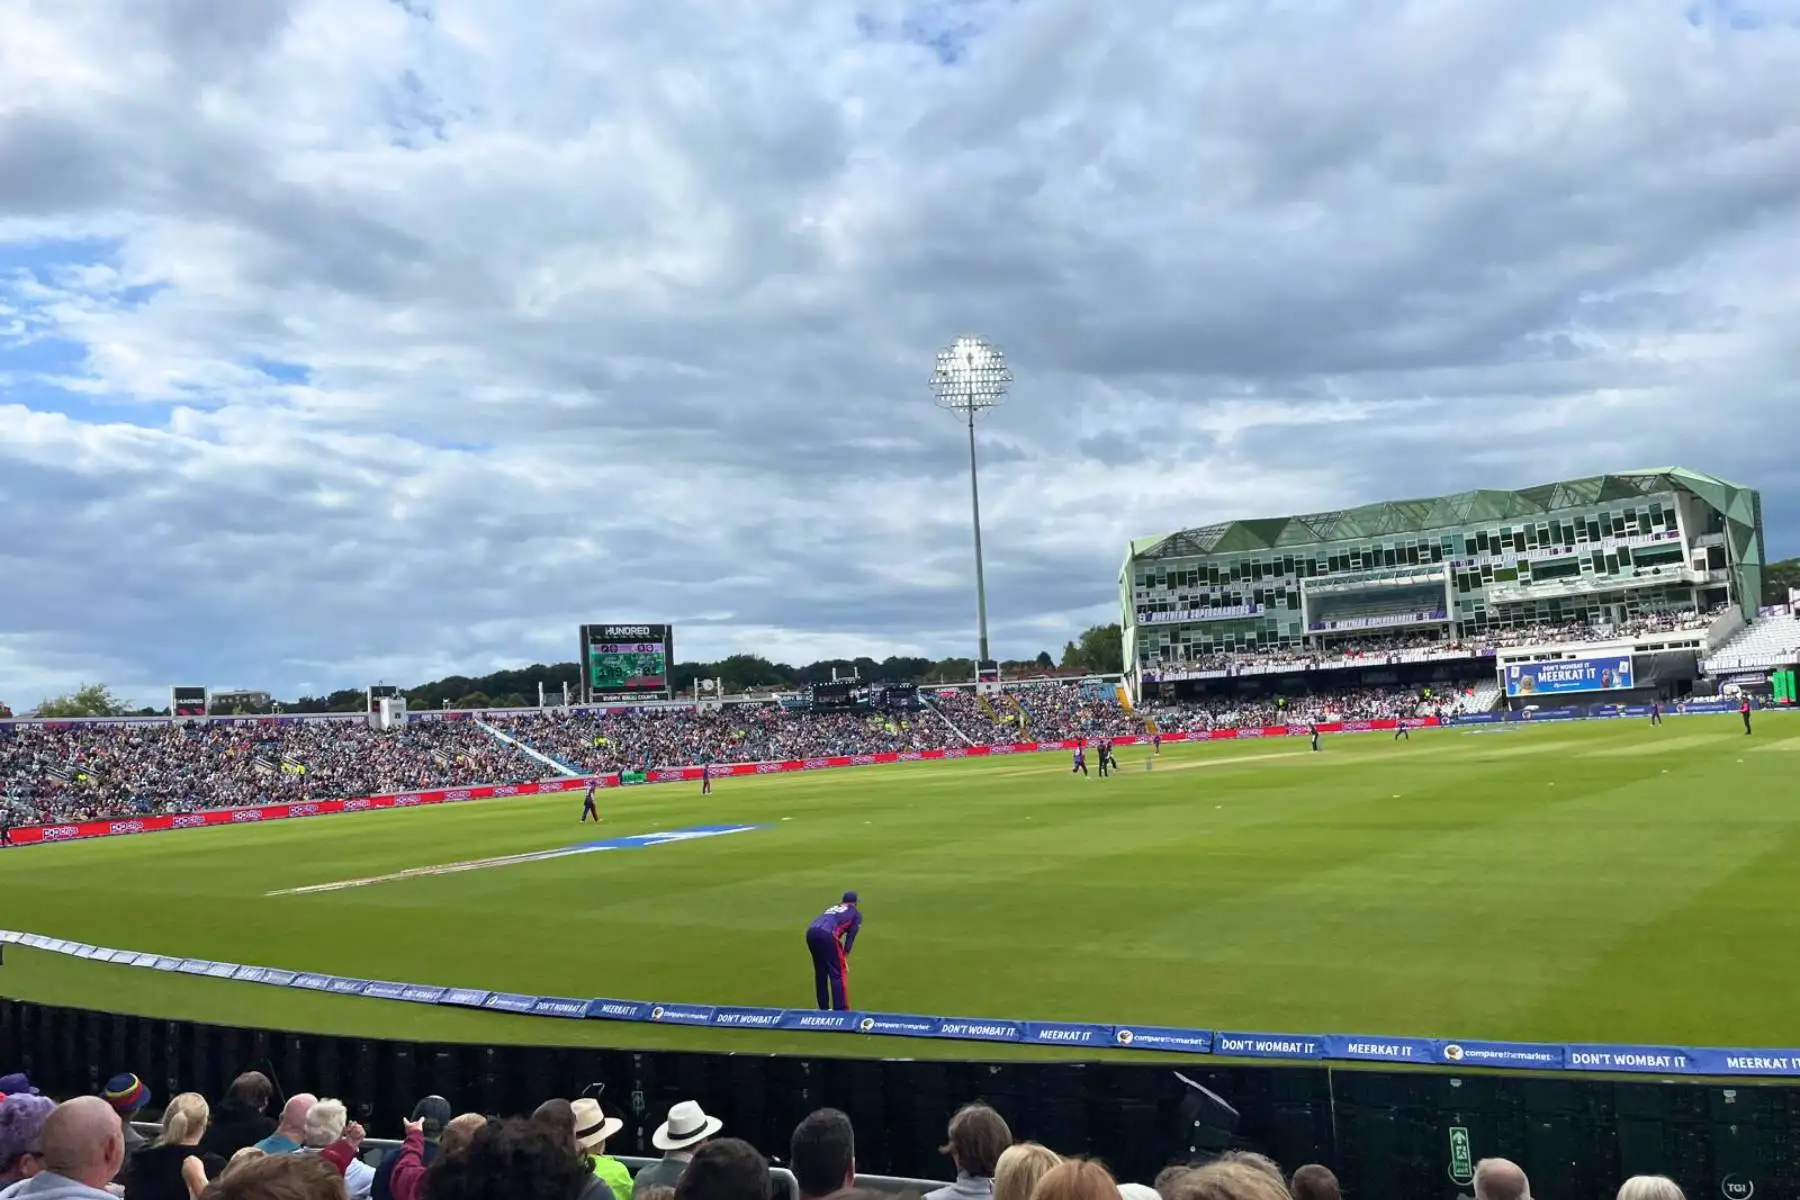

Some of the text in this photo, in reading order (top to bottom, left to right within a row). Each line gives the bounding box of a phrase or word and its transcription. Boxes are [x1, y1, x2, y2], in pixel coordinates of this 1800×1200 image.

[605, 627, 650, 635] HUNDRED
[1538, 668, 1596, 682] MEERKAT IT
[602, 1004, 638, 1016] MEERKAT IT
[717, 1014, 781, 1024] DON'T WOMBAT IT
[800, 1017, 844, 1026] MEERKAT IT
[942, 1024, 1016, 1037] DON'T WOMBAT IT
[1039, 1030, 1092, 1041] MEERKAT IT
[1222, 1039, 1315, 1053] DON'T WOMBAT IT
[1348, 1043, 1412, 1056] MEERKAT IT
[1572, 1053, 1686, 1067] DON'T WOMBAT IT
[1727, 1057, 1787, 1069] MEERKAT
[1727, 1183, 1746, 1192] TGI
